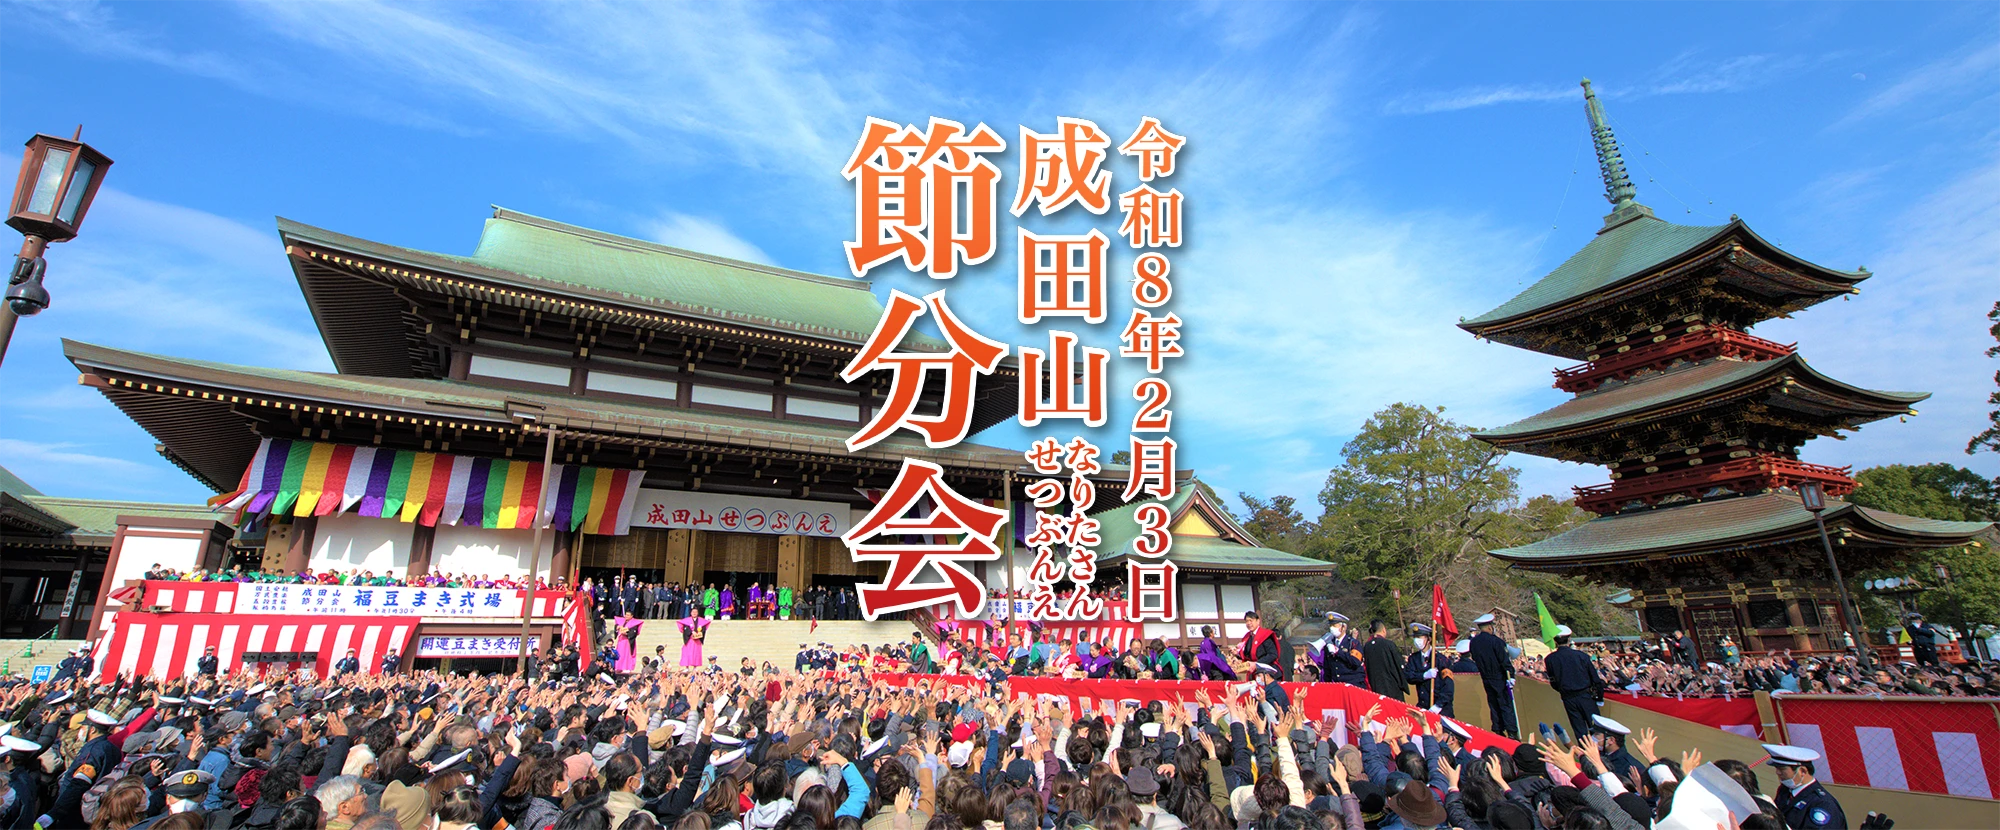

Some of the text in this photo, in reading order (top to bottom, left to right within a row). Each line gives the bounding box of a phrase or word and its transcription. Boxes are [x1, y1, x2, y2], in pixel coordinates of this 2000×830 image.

[302, 588, 341, 597] 成田山
[301, 597, 339, 606] 節分会
[353, 589, 502, 608] 福豆まき式場
